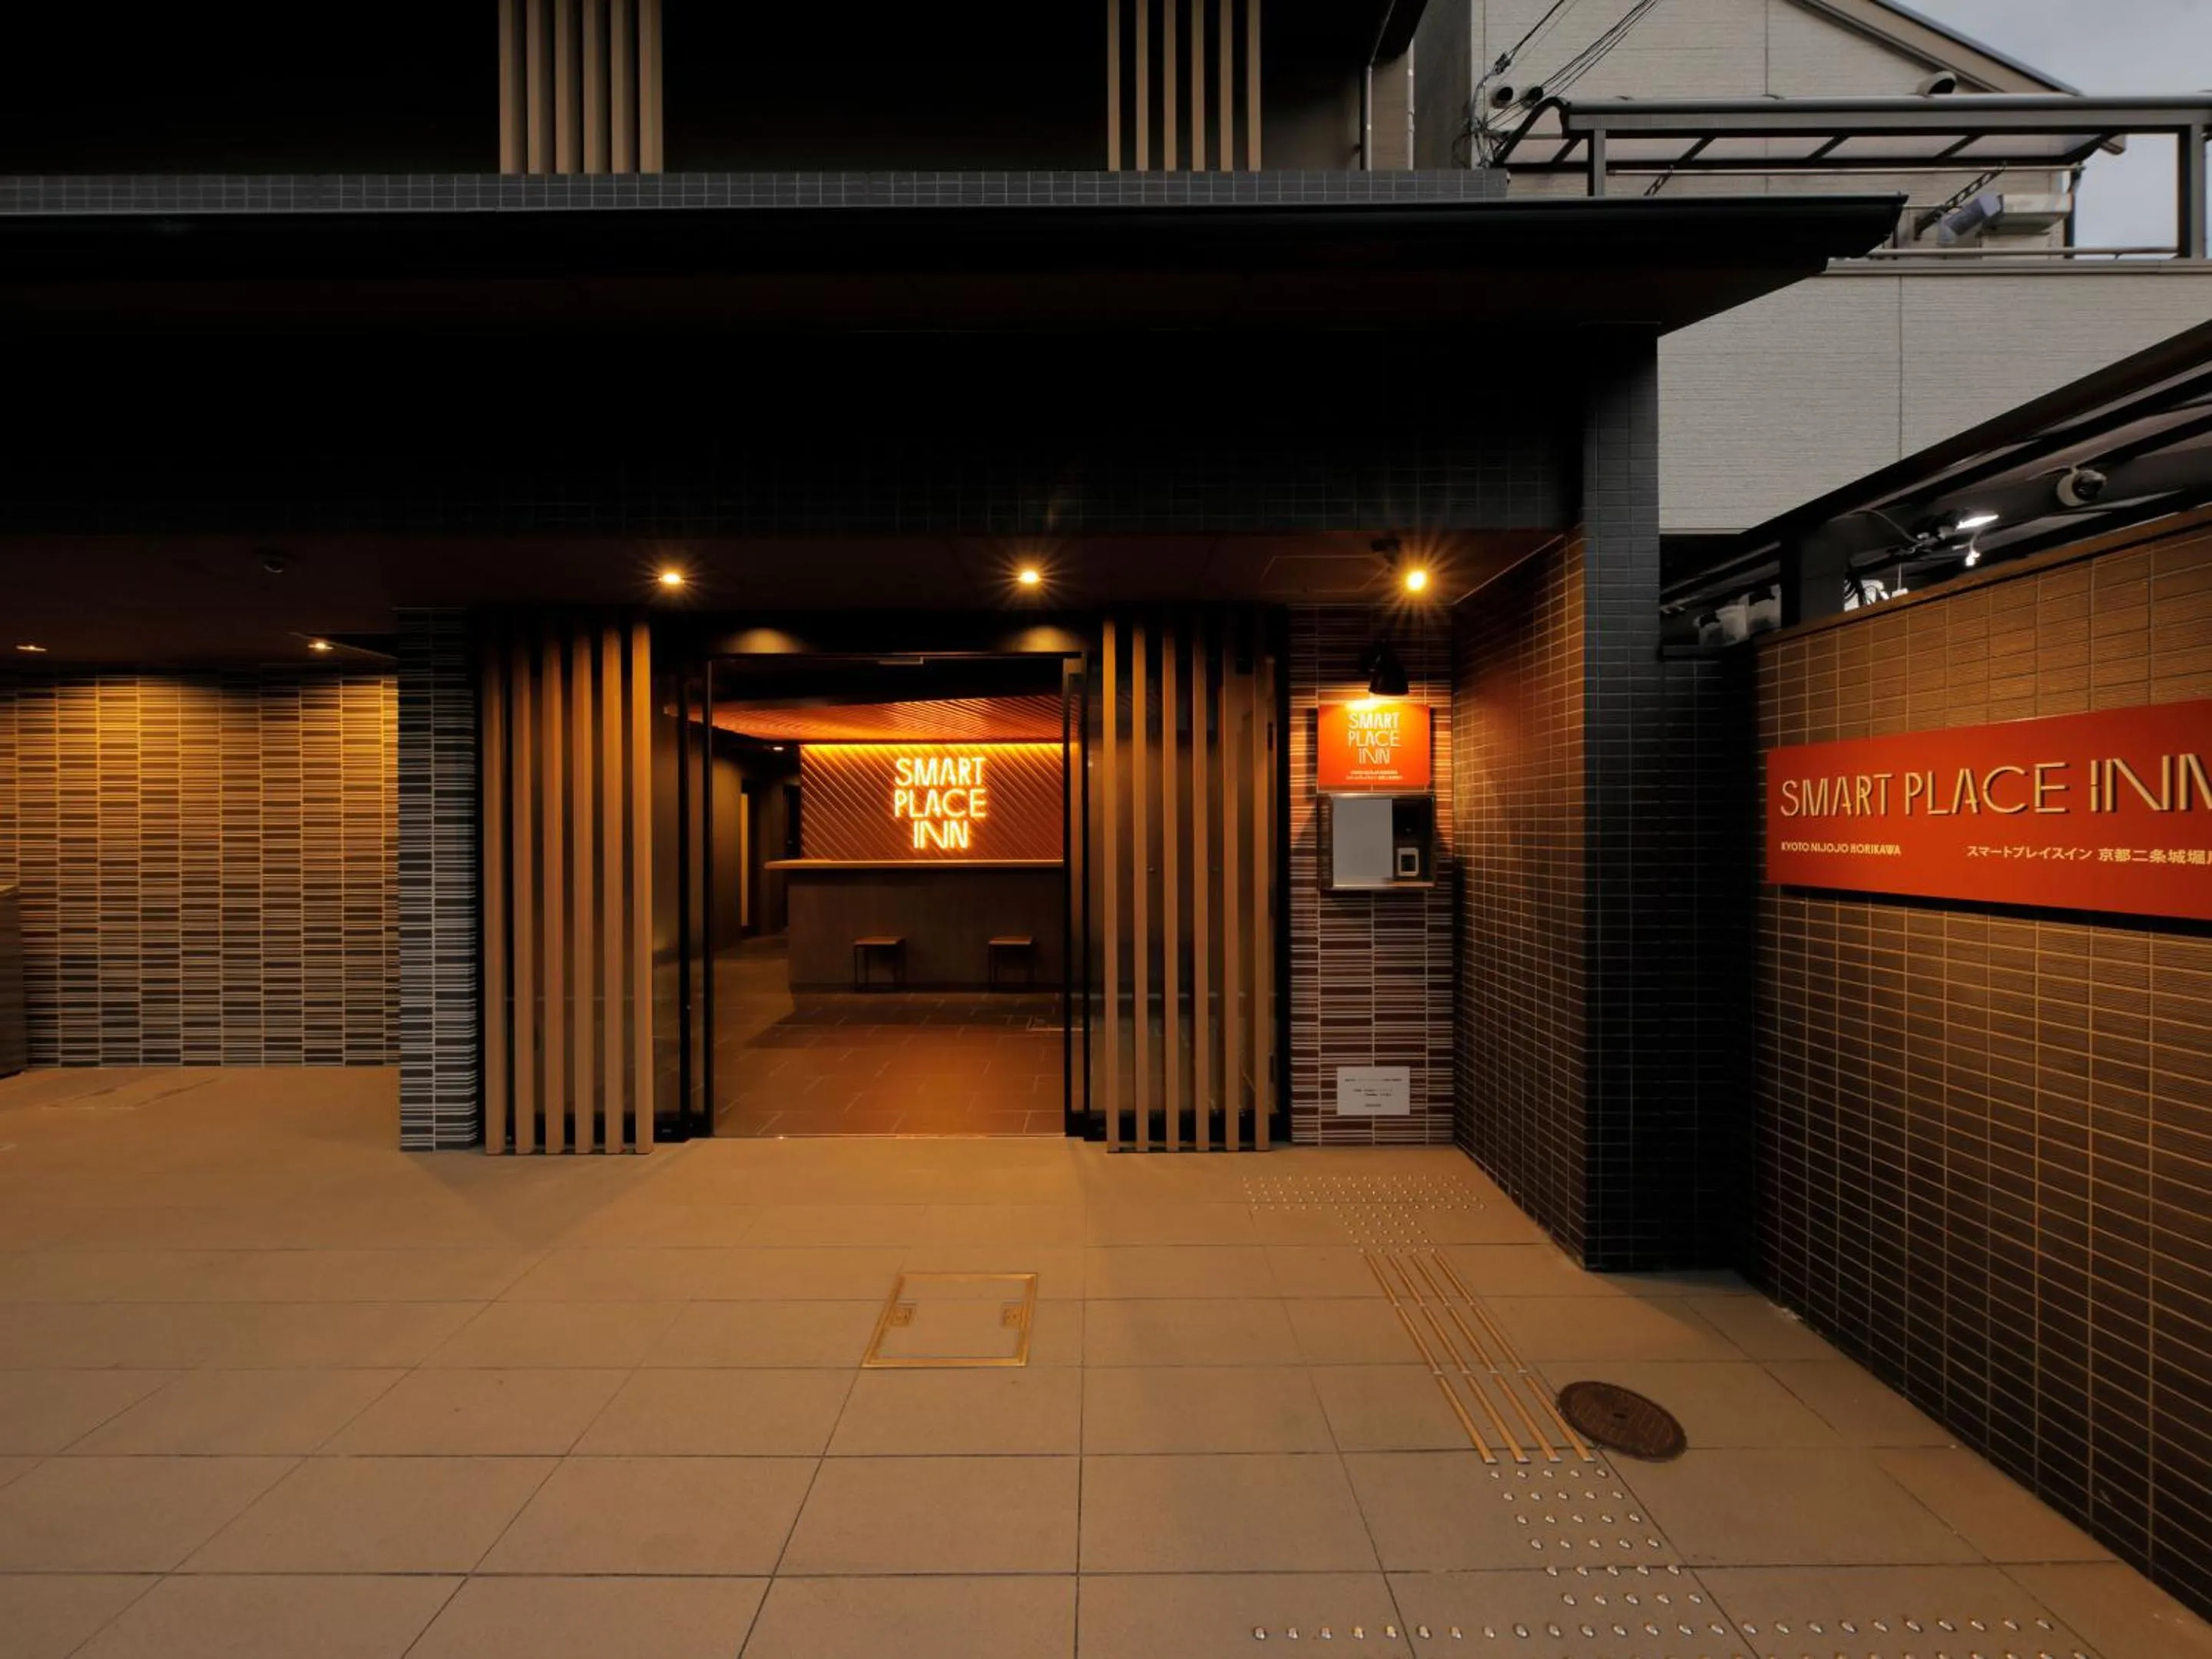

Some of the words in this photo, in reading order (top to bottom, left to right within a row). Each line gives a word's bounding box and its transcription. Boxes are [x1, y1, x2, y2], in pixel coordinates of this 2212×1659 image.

[1348, 711, 1401, 729] SMART
[1348, 730, 1401, 748] PLACE
[1359, 747, 1390, 764] INN
[894, 757, 987, 786] SMART
[1780, 773, 1895, 817] SMART
[1905, 762, 2069, 815] PLACE
[2090, 752, 2212, 813] INN
[894, 788, 987, 818] PLACE
[913, 820, 969, 849] INN
[1781, 841, 1810, 852] KYOTO
[1810, 842, 1849, 854] NIJOJO
[1849, 843, 1902, 856] HORIKAWA
[1966, 845, 2093, 861] スマートプレイスイン
